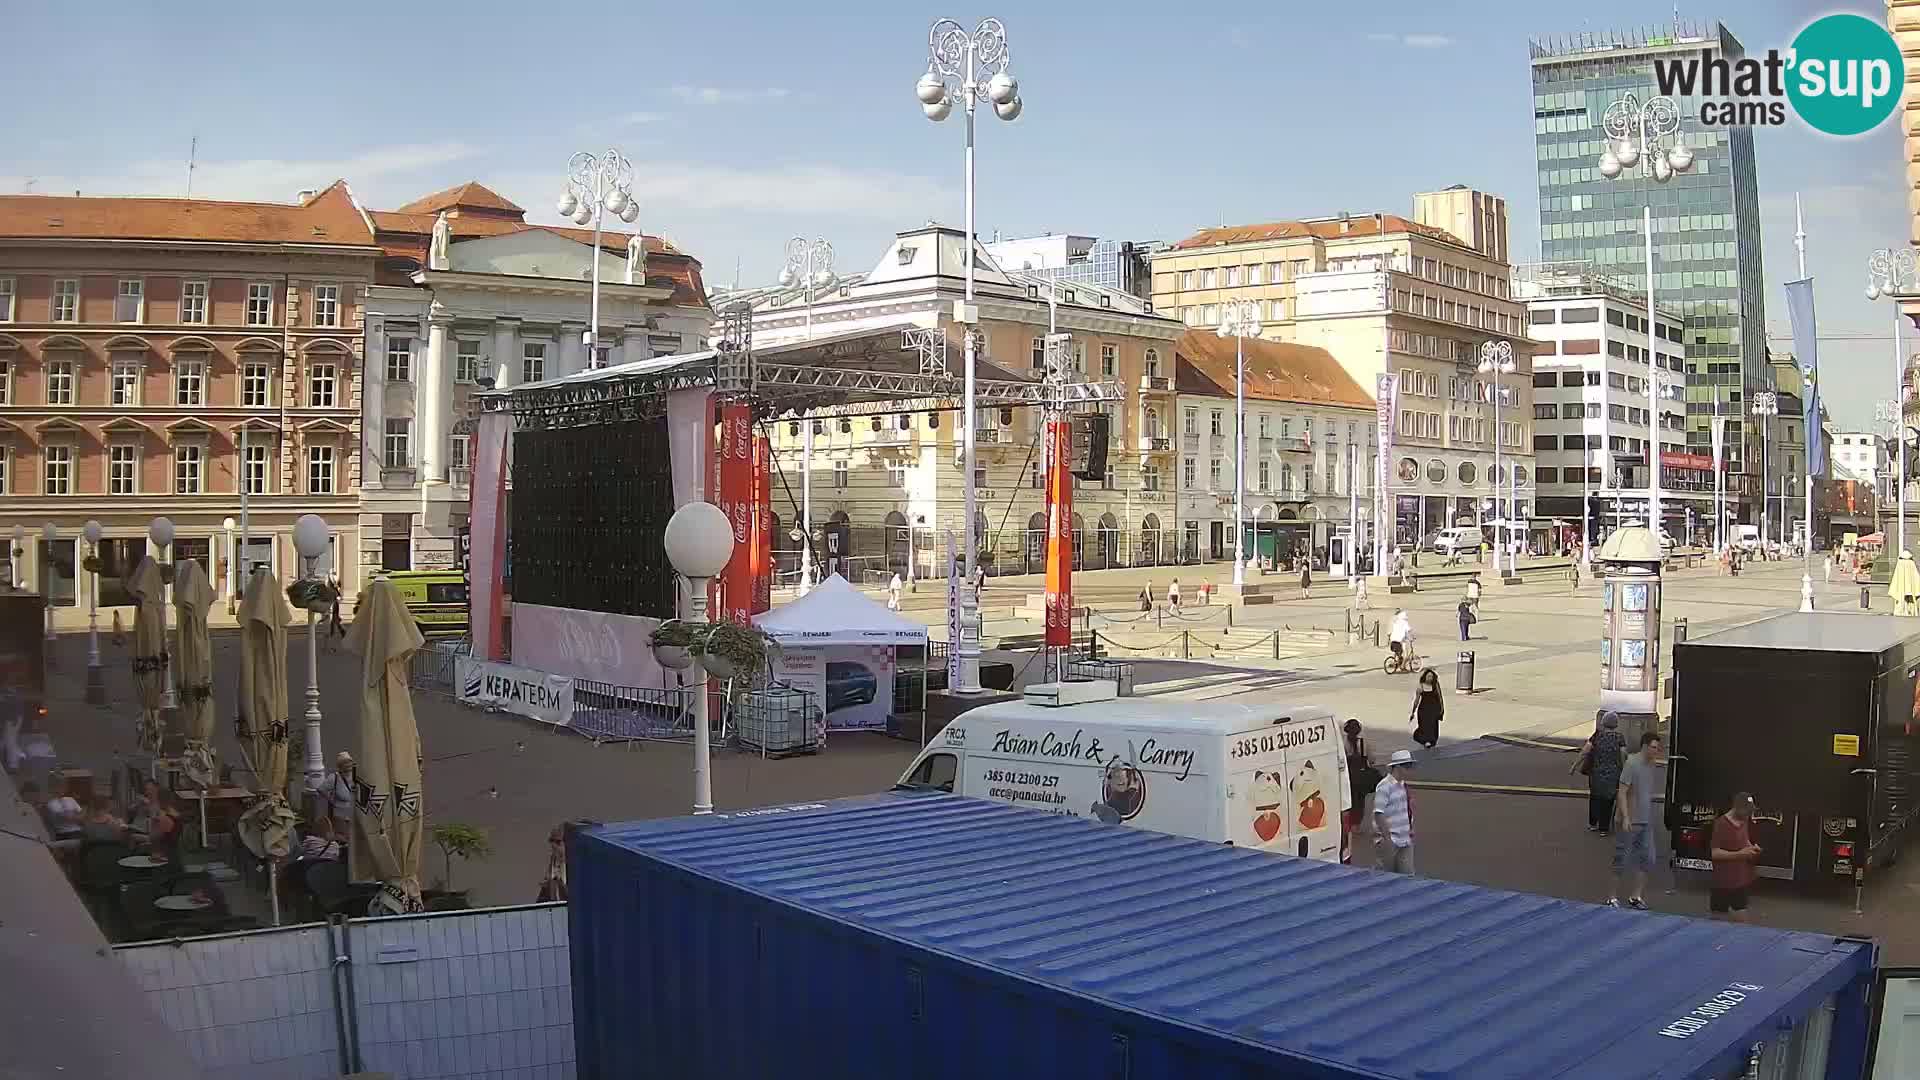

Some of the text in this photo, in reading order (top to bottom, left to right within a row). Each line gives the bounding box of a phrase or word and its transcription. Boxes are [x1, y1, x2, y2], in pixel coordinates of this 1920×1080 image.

[486, 675, 561, 711] KERATERM
[992, 729, 1196, 781] Asian Cash & Carry
[1230, 725, 1326, 759] +385 01 2300 257
[1005, 771, 1017, 784] 01
[1017, 772, 1041, 786] 2300
[1042, 775, 1059, 788] 257
[1691, 990, 1747, 1018] 300629
